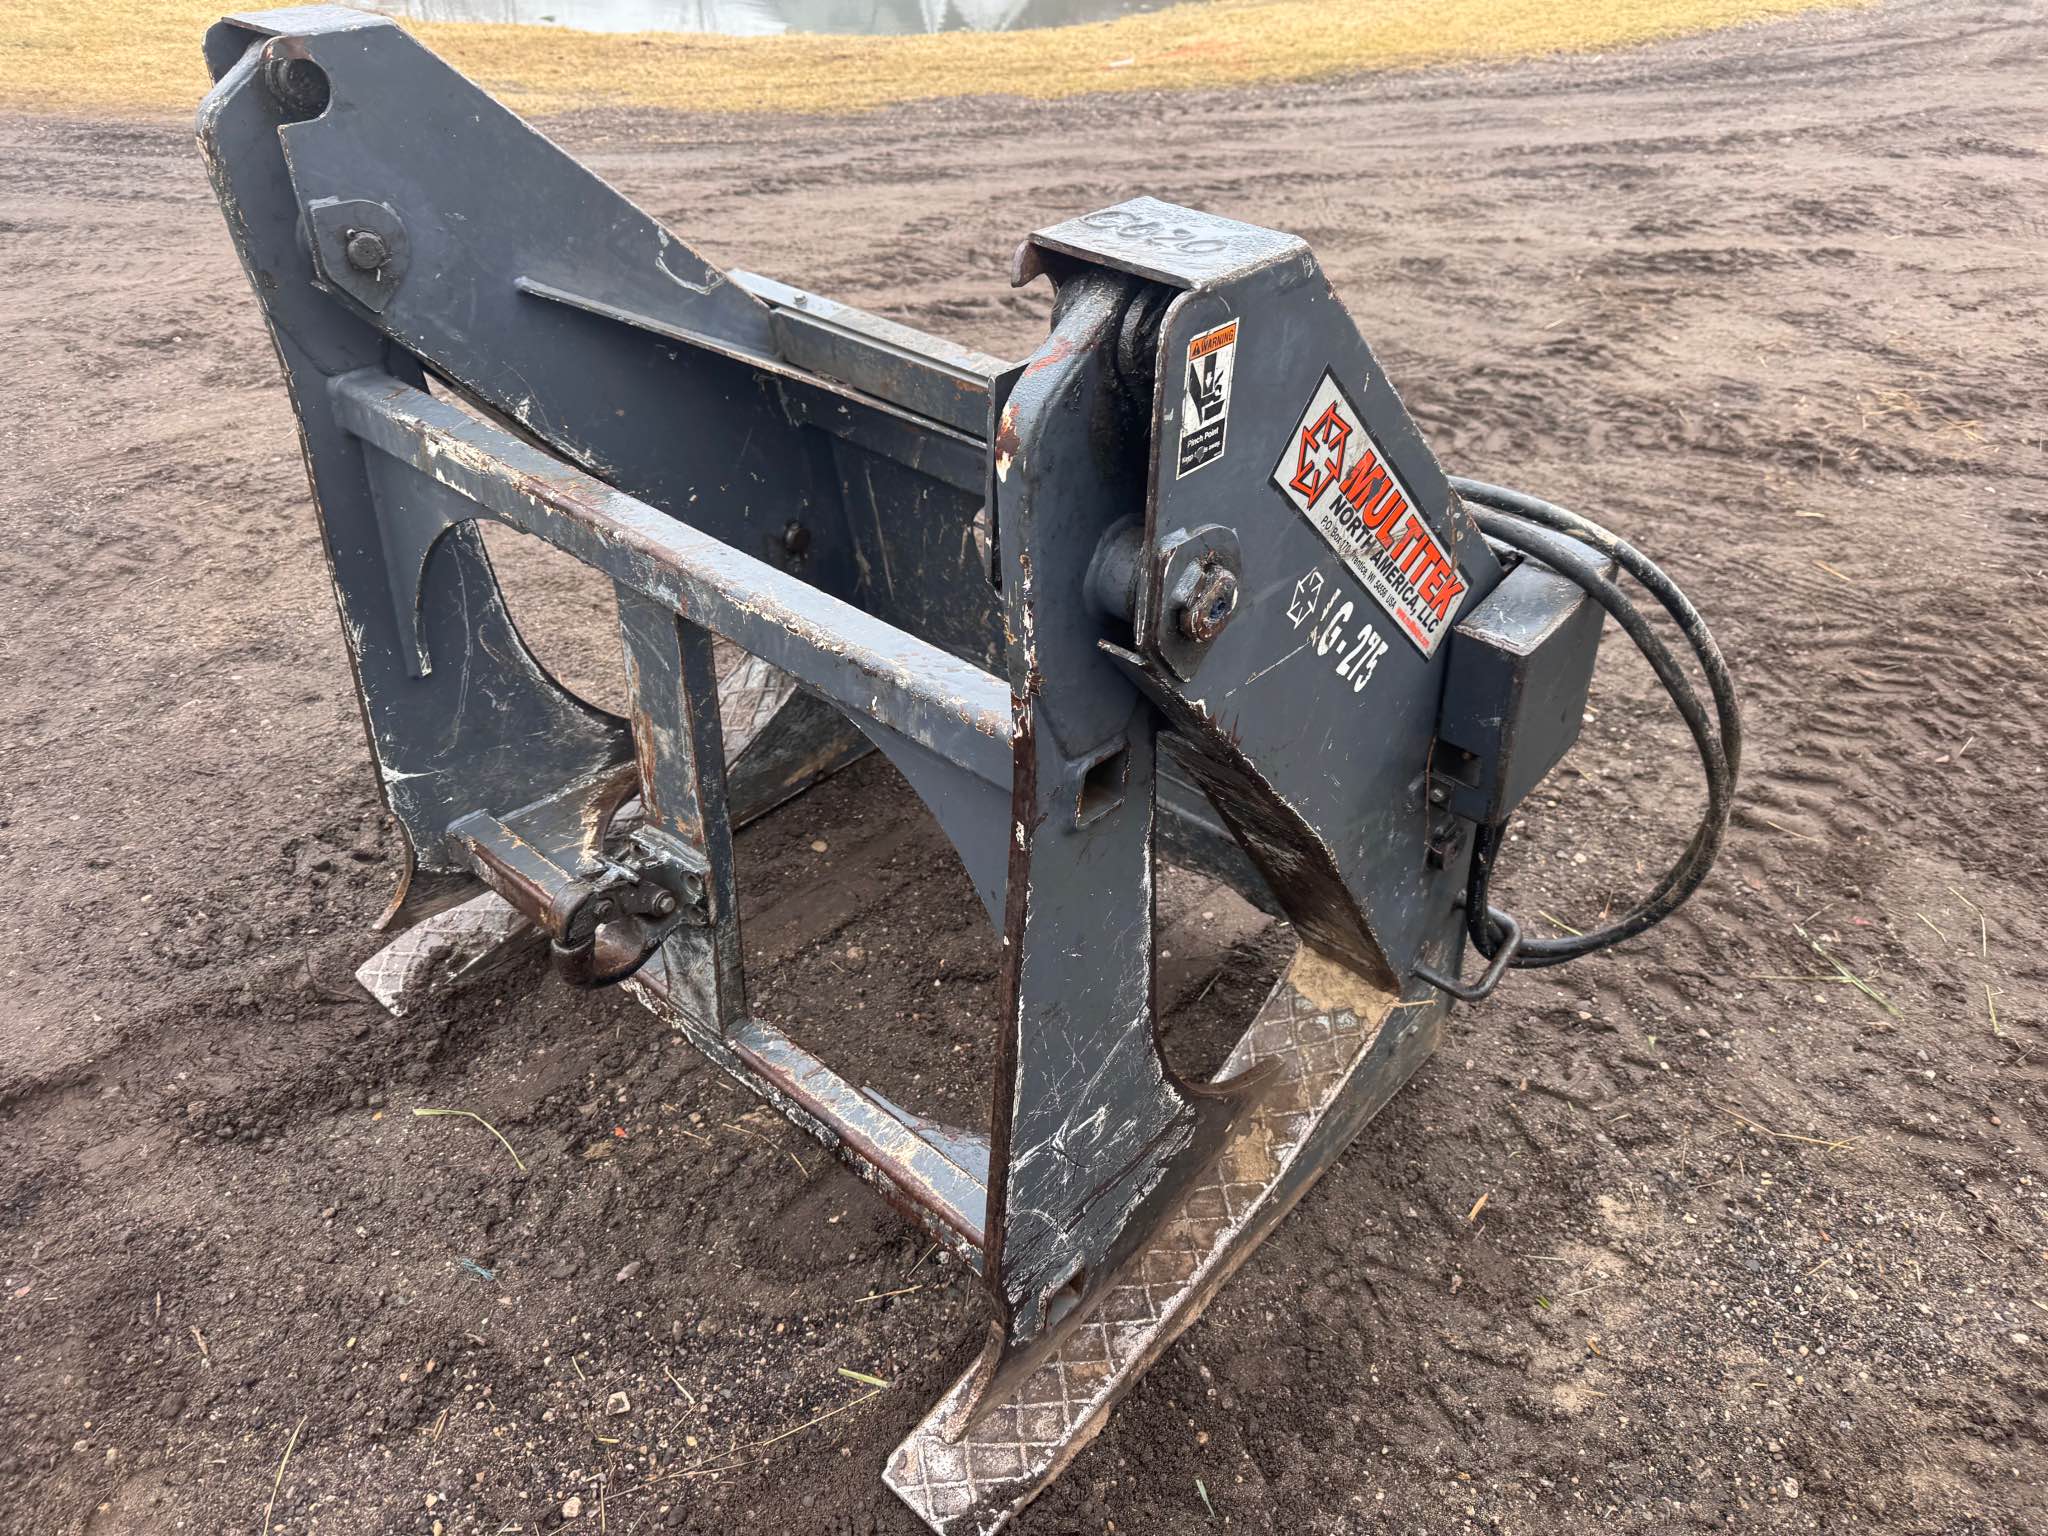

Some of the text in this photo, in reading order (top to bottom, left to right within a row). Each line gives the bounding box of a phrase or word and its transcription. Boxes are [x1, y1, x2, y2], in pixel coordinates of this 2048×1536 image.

[1200, 329, 1234, 352] WARNING
[1187, 427, 1219, 448] Pinch Point
[1329, 494, 1377, 554] NORTH
[1369, 549, 1420, 616] AMERICA,
[1417, 605, 1439, 633] LLC
[1331, 527, 1342, 544] Box
[1367, 571, 1376, 584] WI
[1386, 594, 1397, 609] USA
[1338, 448, 1465, 622] MULTITEK
